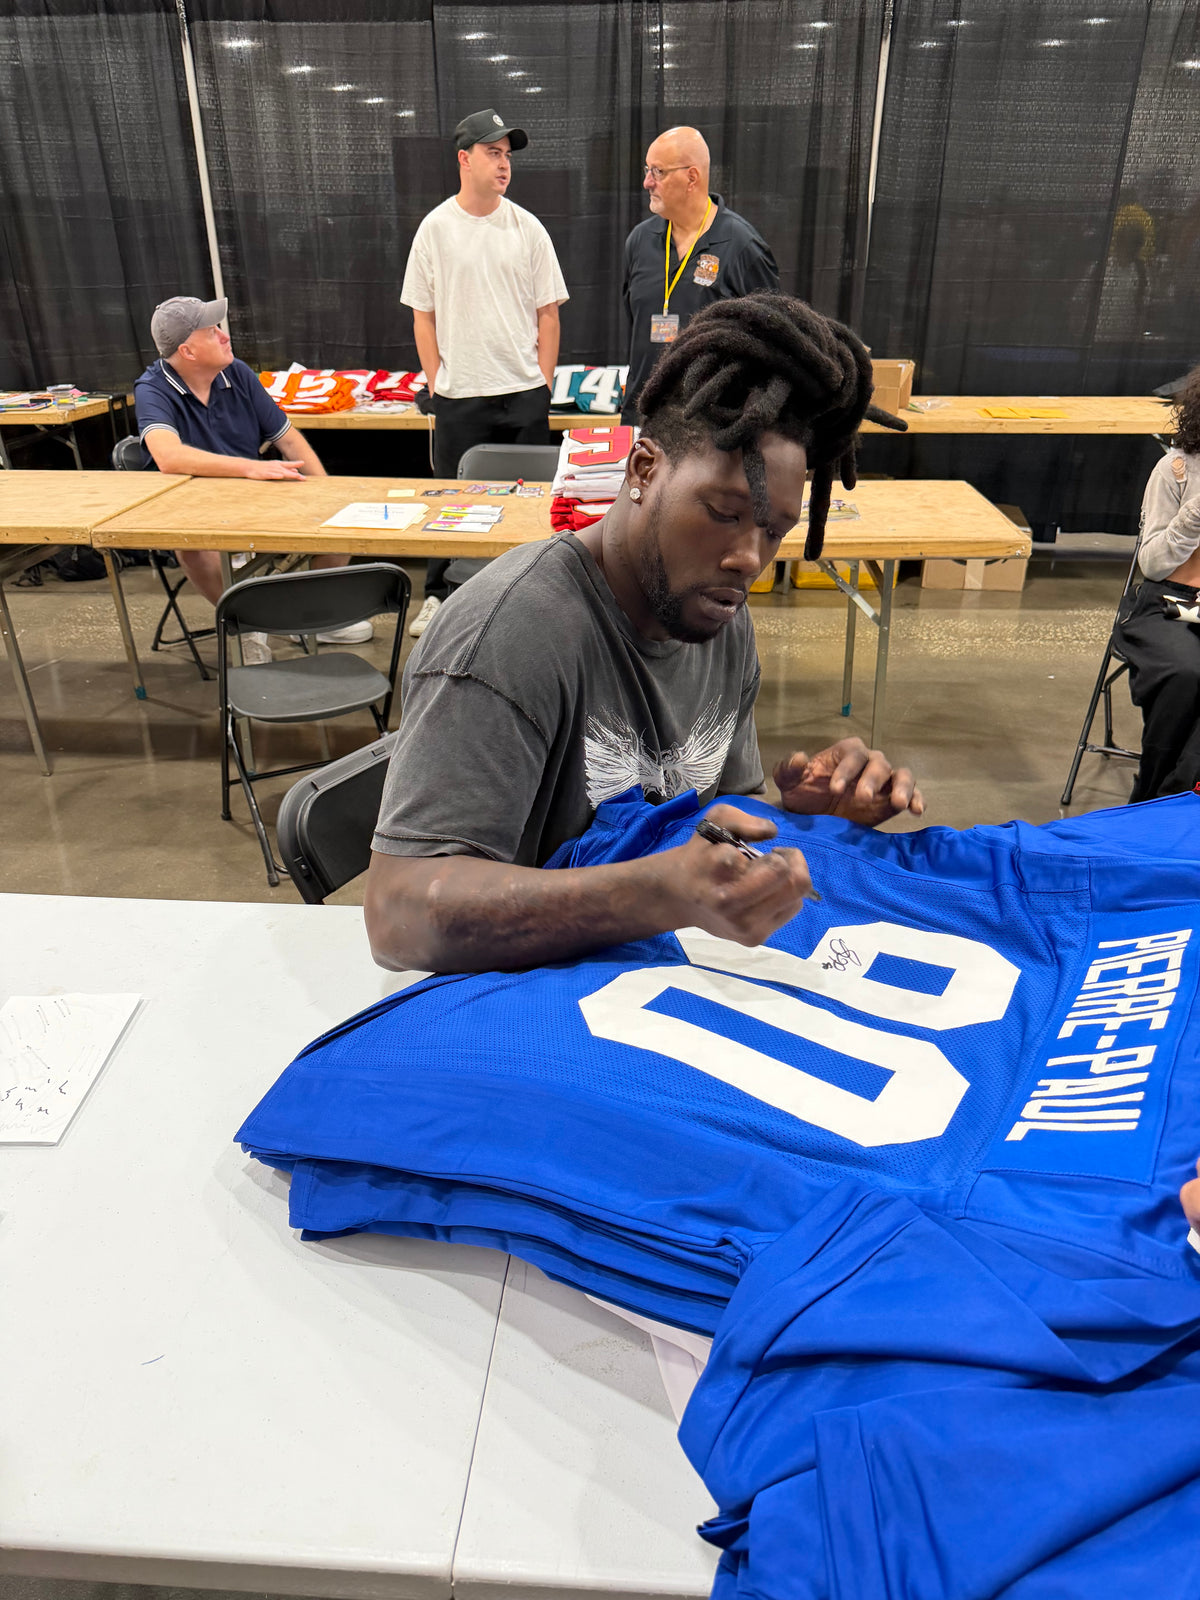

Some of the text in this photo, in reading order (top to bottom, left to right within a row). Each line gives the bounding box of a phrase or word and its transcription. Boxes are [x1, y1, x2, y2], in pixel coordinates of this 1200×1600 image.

[551, 365, 619, 413] 14
[578, 921, 1021, 1147] 90
[1005, 929, 1193, 1141] PIERRE-PAUL
